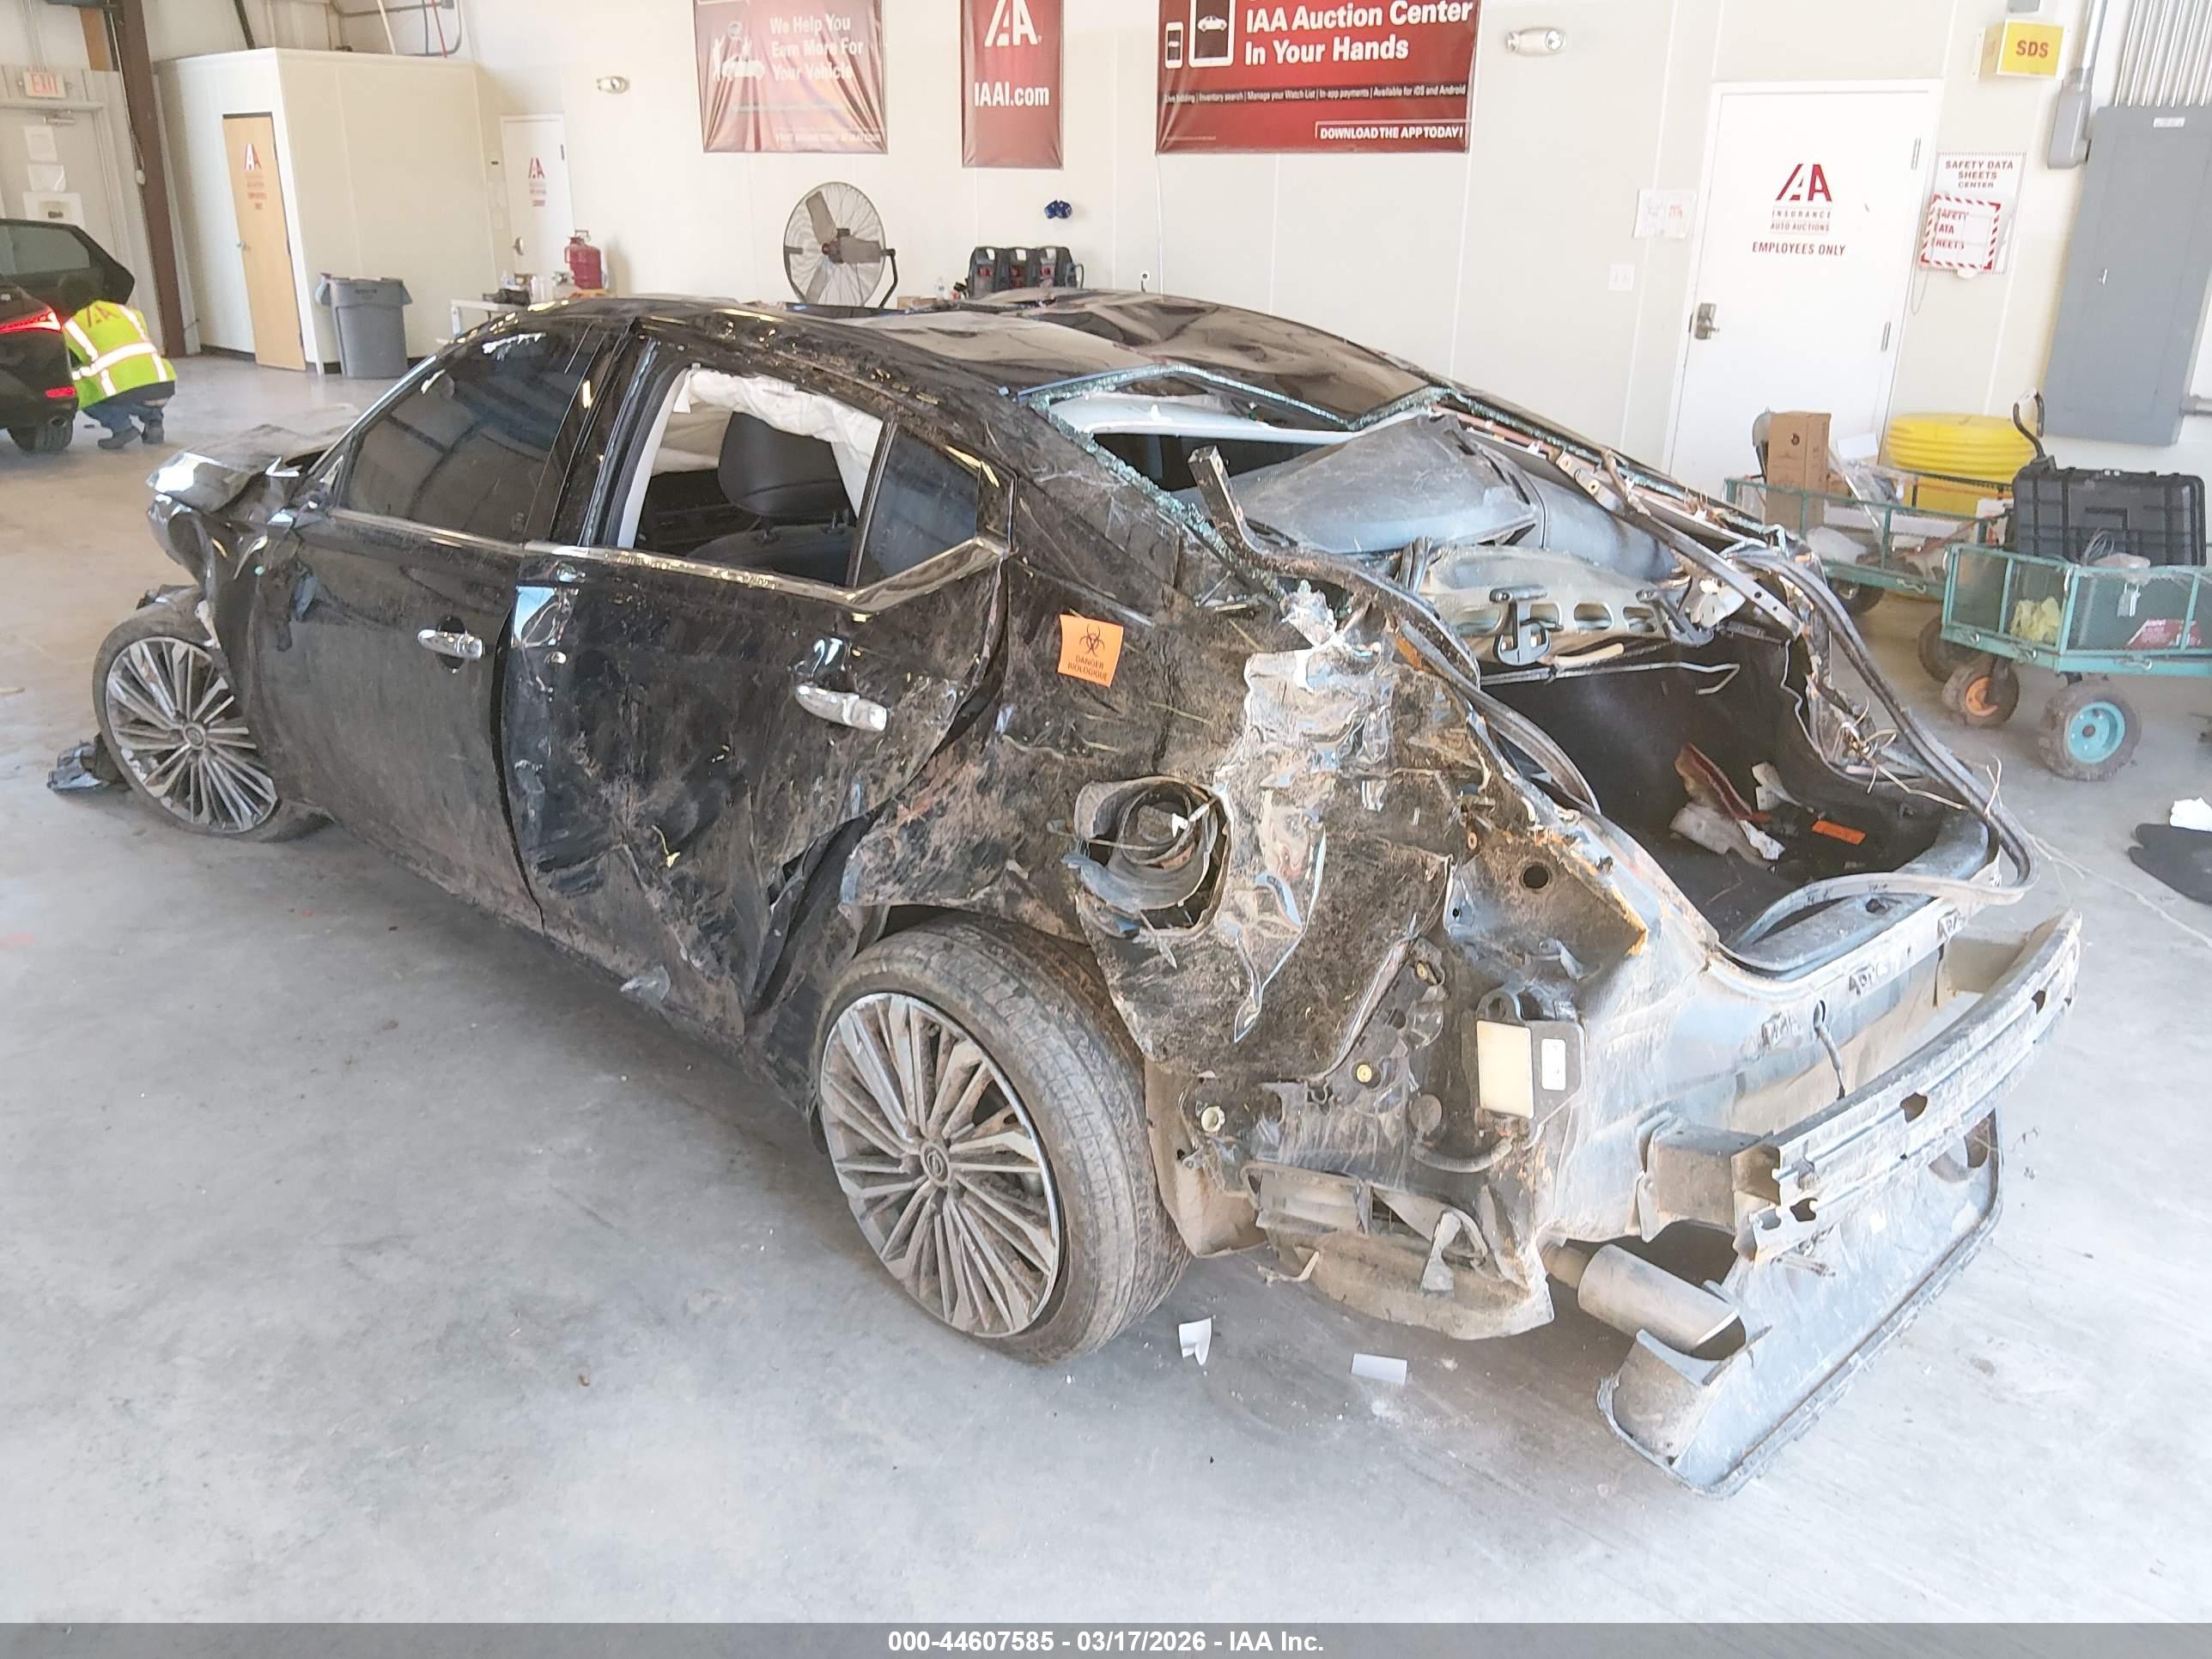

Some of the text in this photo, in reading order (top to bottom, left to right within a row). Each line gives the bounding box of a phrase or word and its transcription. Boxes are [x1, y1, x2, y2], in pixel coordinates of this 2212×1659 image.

[769, 13, 851, 35] We Help You
[1246, 0, 1474, 33] IAA Auction Center
[803, 40, 838, 56] More
[841, 36, 864, 55] For
[1245, 33, 1409, 65] In Your Hands
[2015, 39, 2049, 58] SDS
[772, 64, 802, 81] Your
[974, 81, 1050, 107] IAAI.com
[1320, 127, 1379, 139] DOWNLOAD
[1379, 127, 1400, 138] THE
[1401, 126, 1423, 138] APP
[1945, 161, 2014, 170] SAFETY DATA
[1771, 210, 1832, 219] INSURANCE
[1792, 223, 1830, 232] AUCTIONS
[1752, 241, 1845, 256] EMPLOYEES ONLY
[1075, 654, 1104, 670] DANGER
